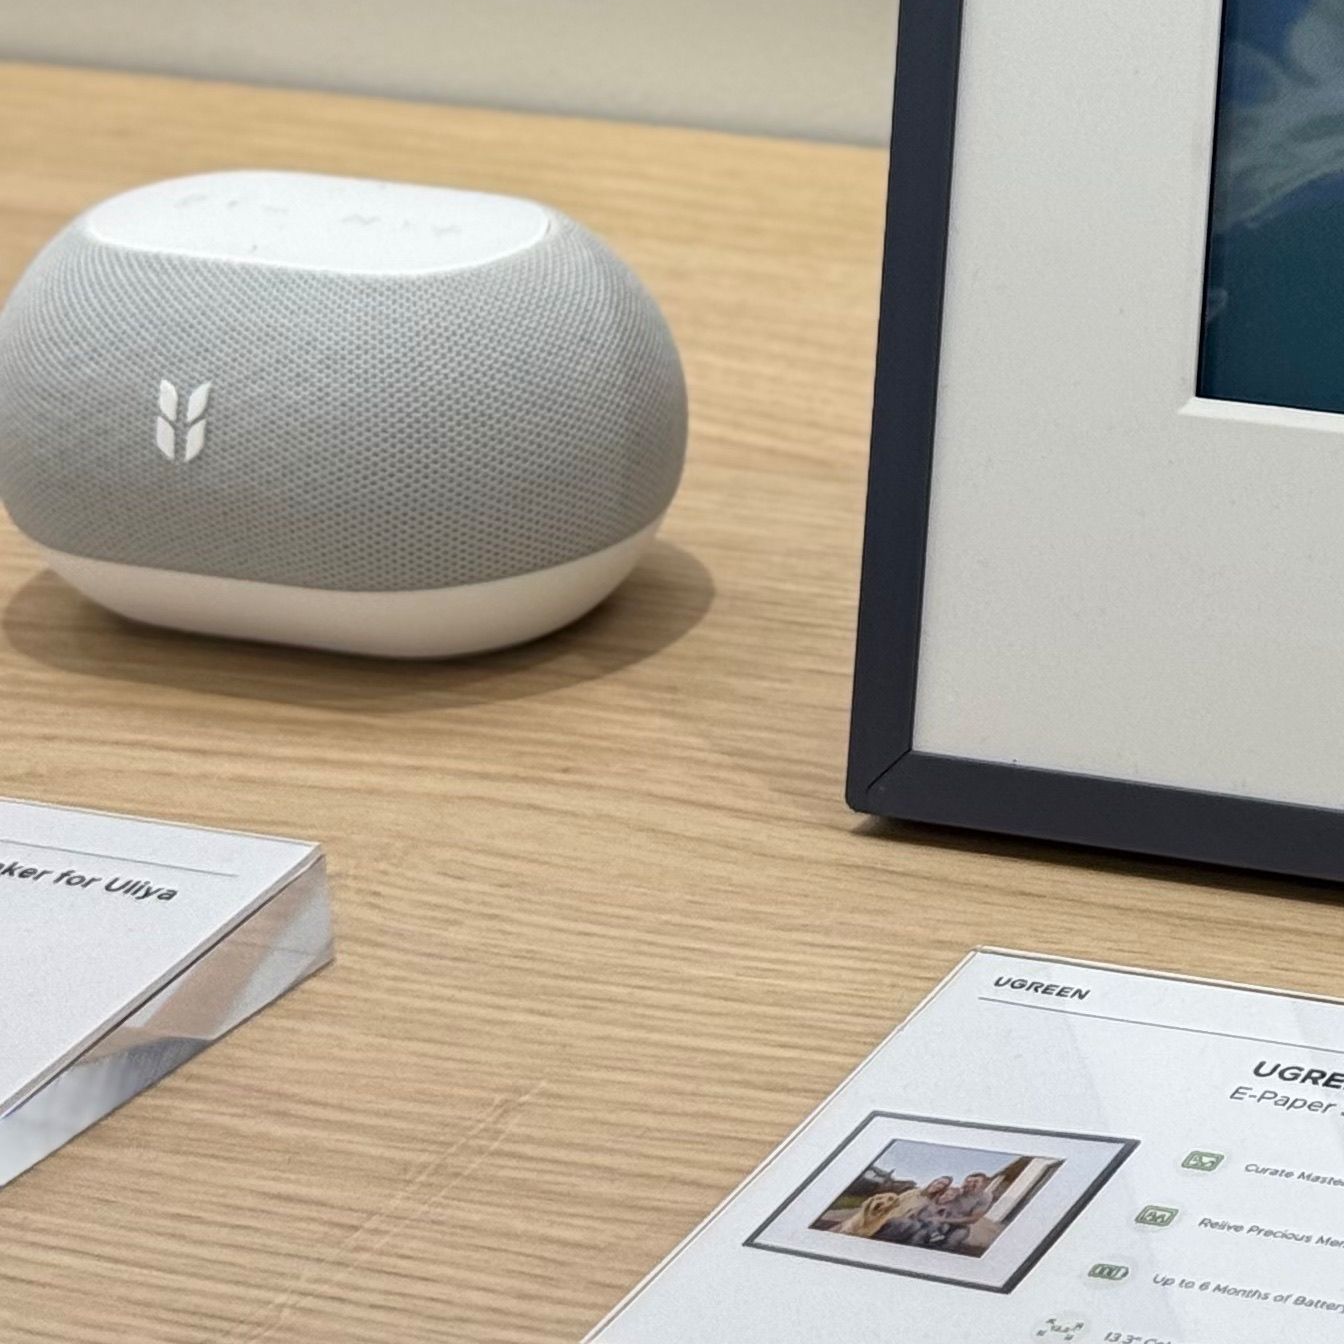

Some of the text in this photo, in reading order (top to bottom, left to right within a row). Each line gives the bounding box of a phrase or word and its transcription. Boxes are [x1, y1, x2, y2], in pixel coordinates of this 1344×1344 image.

[53, 869, 103, 888] for
[105, 877, 178, 901] Uliya
[994, 976, 1091, 1000] UGREEN
[1229, 1086, 1338, 1113] E-Paper
[1244, 1163, 1295, 1180] Curate
[1198, 1217, 1245, 1234] Relive
[1247, 1224, 1312, 1244] Precious
[1152, 1273, 1175, 1288] Up
[1178, 1278, 1197, 1290] to
[1198, 1280, 1210, 1292] 6
[1212, 1283, 1271, 1302] Months
[1272, 1292, 1294, 1304] of
